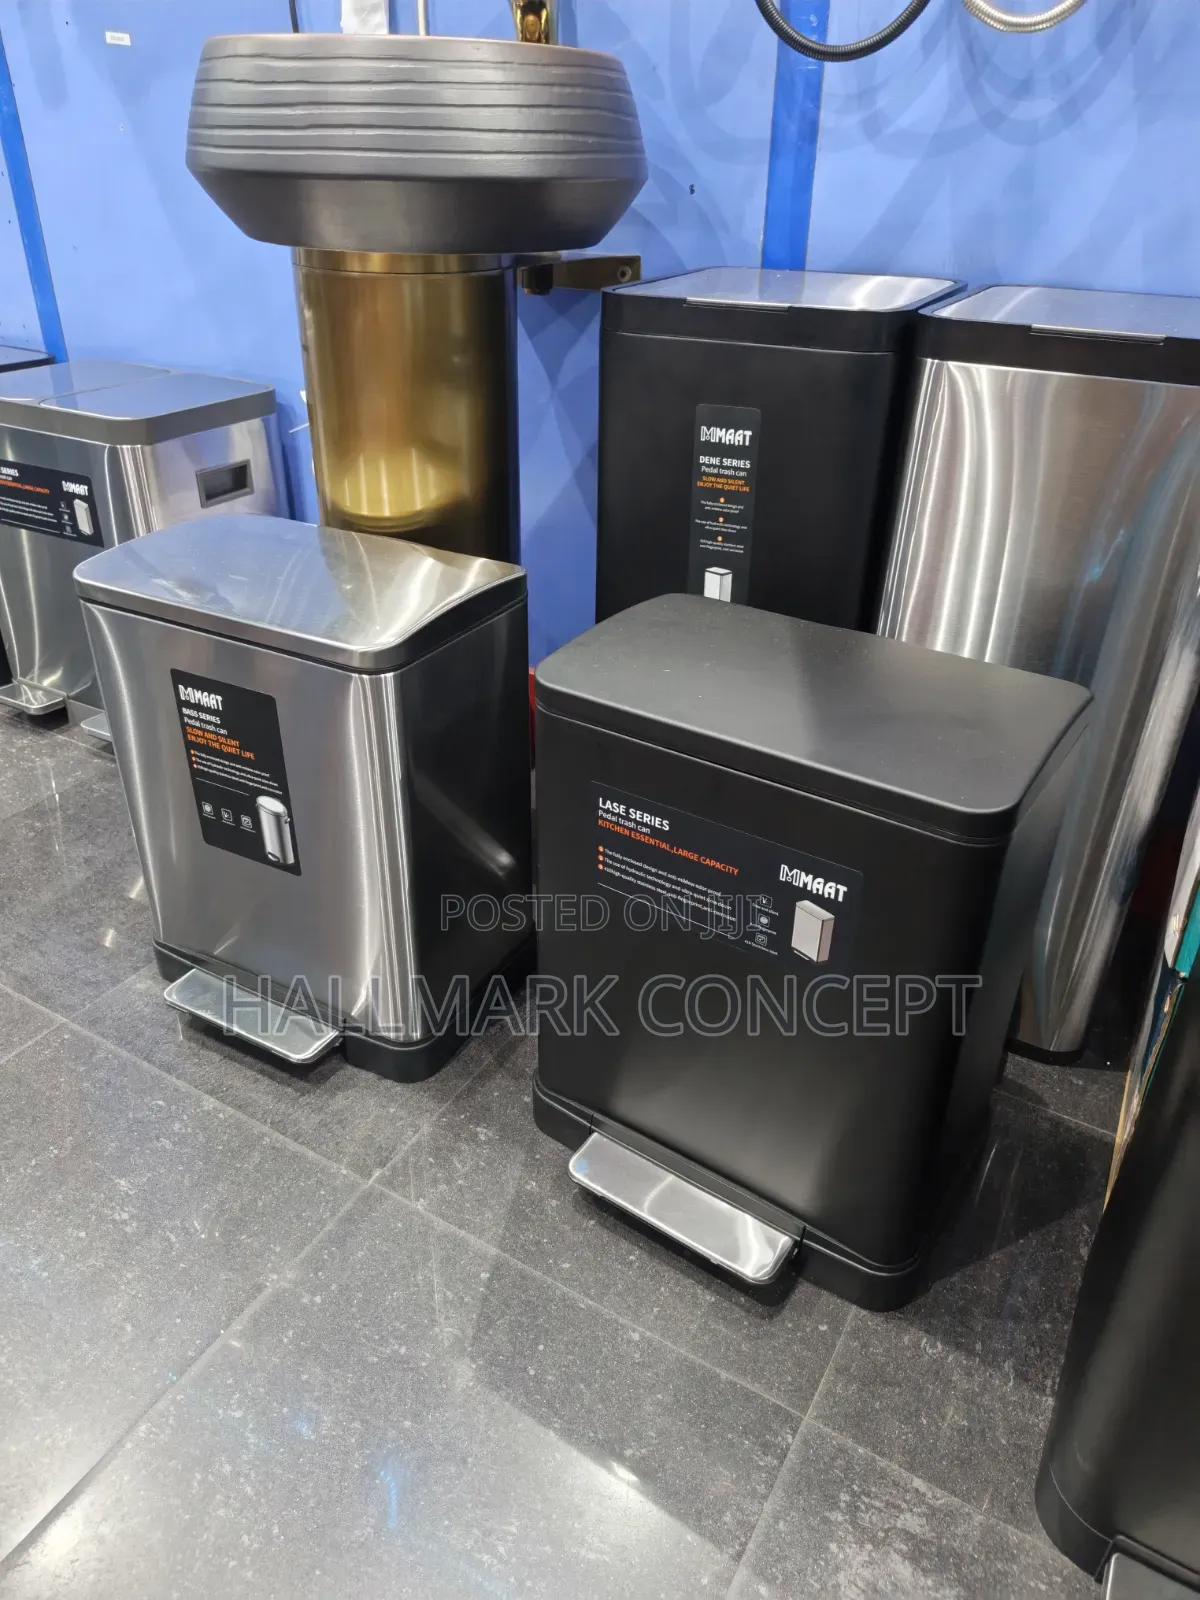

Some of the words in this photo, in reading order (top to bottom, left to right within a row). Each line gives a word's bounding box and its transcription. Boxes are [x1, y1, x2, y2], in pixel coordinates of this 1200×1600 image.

[0, 466, 19, 477] SERIES
[699, 455, 721, 465] DENE
[722, 458, 751, 468] SERIES
[701, 465, 719, 474] Pedal
[719, 468, 735, 476] trash
[184, 716, 200, 728] Pedal
[200, 721, 216, 733] trash
[216, 727, 228, 736] can
[198, 711, 221, 725] SERIES
[186, 726, 203, 737] SLOW
[204, 731, 217, 741] AND
[218, 735, 240, 748] SILENT
[187, 733, 207, 746] ENJOY
[208, 738, 221, 750] THE
[221, 743, 241, 757] QUIET
[241, 749, 256, 760] LIFE
[598, 809, 618, 822] Pedal
[618, 817, 637, 830] trash
[637, 825, 651, 834] can
[599, 797, 627, 816] LASE
[628, 808, 670, 831] SERIES
[598, 819, 630, 837] KITCHEN
[700, 856, 739, 876] CAPACITY
